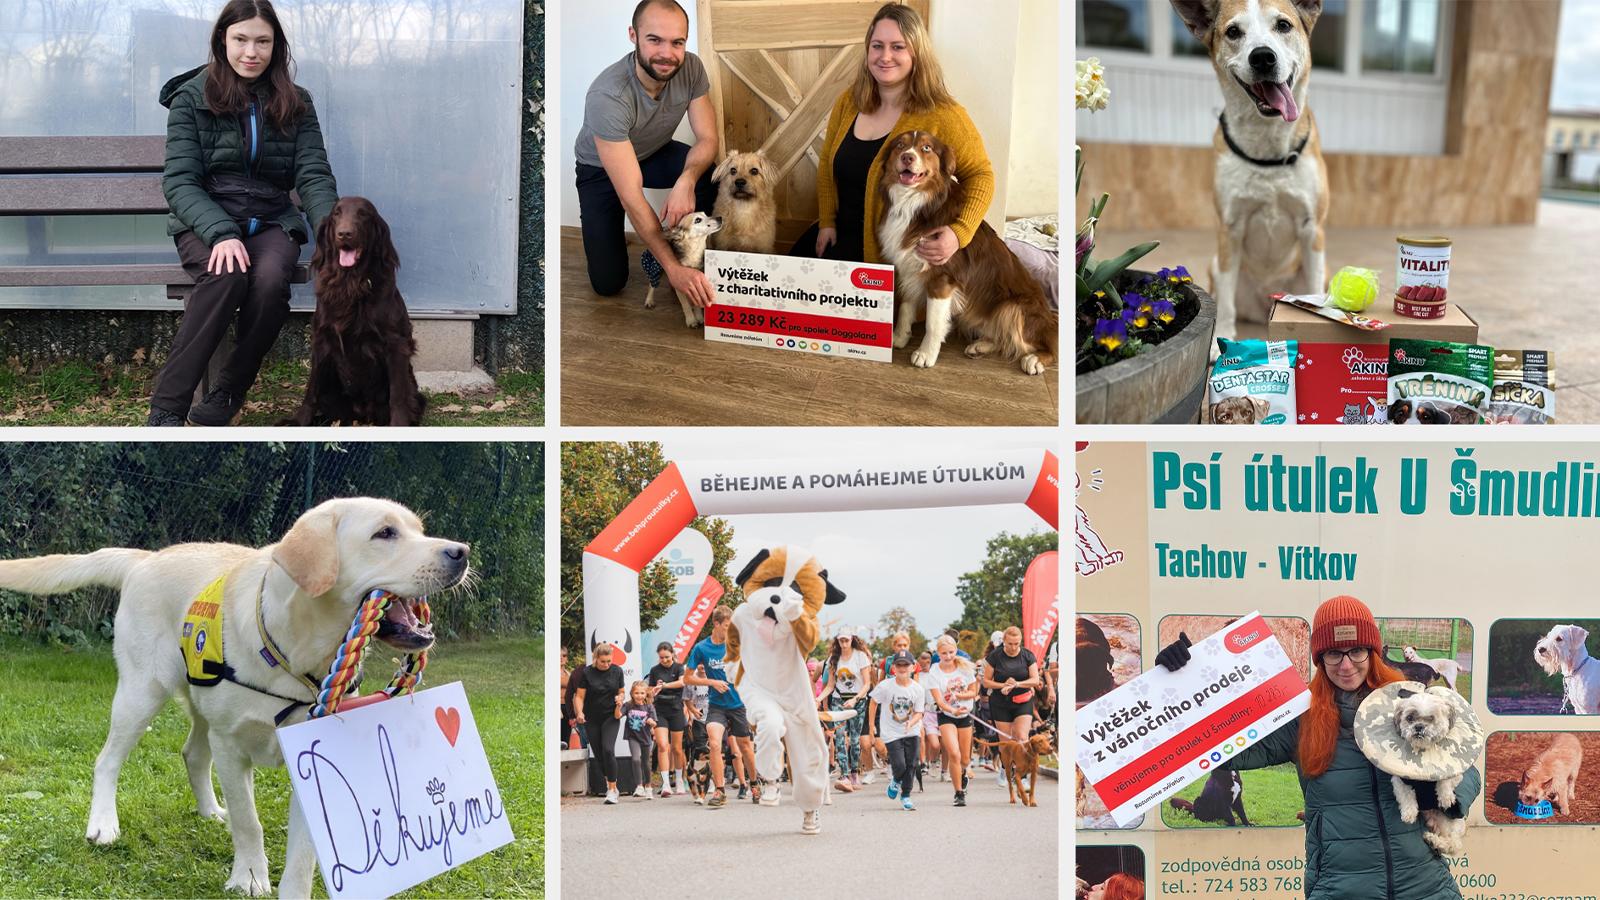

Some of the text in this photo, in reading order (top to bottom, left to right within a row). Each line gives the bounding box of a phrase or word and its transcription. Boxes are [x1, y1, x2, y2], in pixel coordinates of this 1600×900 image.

[717, 267, 769, 283] Výtěžek
[717, 282, 878, 309] z charitativního projektu
[717, 310, 735, 323] 23
[739, 313, 765, 327] 289
[769, 317, 787, 330] Kč
[831, 327, 877, 341] Doggoland
[1468, 347, 1487, 355] SMART
[1213, 370, 1289, 393] DENTASTAR
[1351, 361, 1389, 374] AKIN
[1250, 385, 1286, 394] CROSSES
[1395, 374, 1485, 408] TRÉNINK
[700, 461, 1026, 493] BĚHEJME A POMÁHEJME ÚTULKŮM
[1152, 450, 1223, 511] Psí
[1244, 453, 1379, 514] útulek
[1400, 457, 1428, 516] U
[612, 488, 679, 553] www.behproutulky.cz
[1154, 542, 1248, 579] Tachov
[1278, 545, 1357, 581] Vítkov
[1080, 698, 1153, 746] Výtěžek
[1093, 663, 1253, 764] z vánočního prodeje
[1113, 763, 1159, 795] věnujeme
[1159, 751, 1175, 769] pro
[1175, 735, 1204, 757] útulek
[1203, 730, 1212, 740] U
[297, 723, 503, 893] Děkujeme
[1161, 856, 1308, 876] zodpovědná osob
[1161, 876, 1302, 894] tel.: 724 583 768
